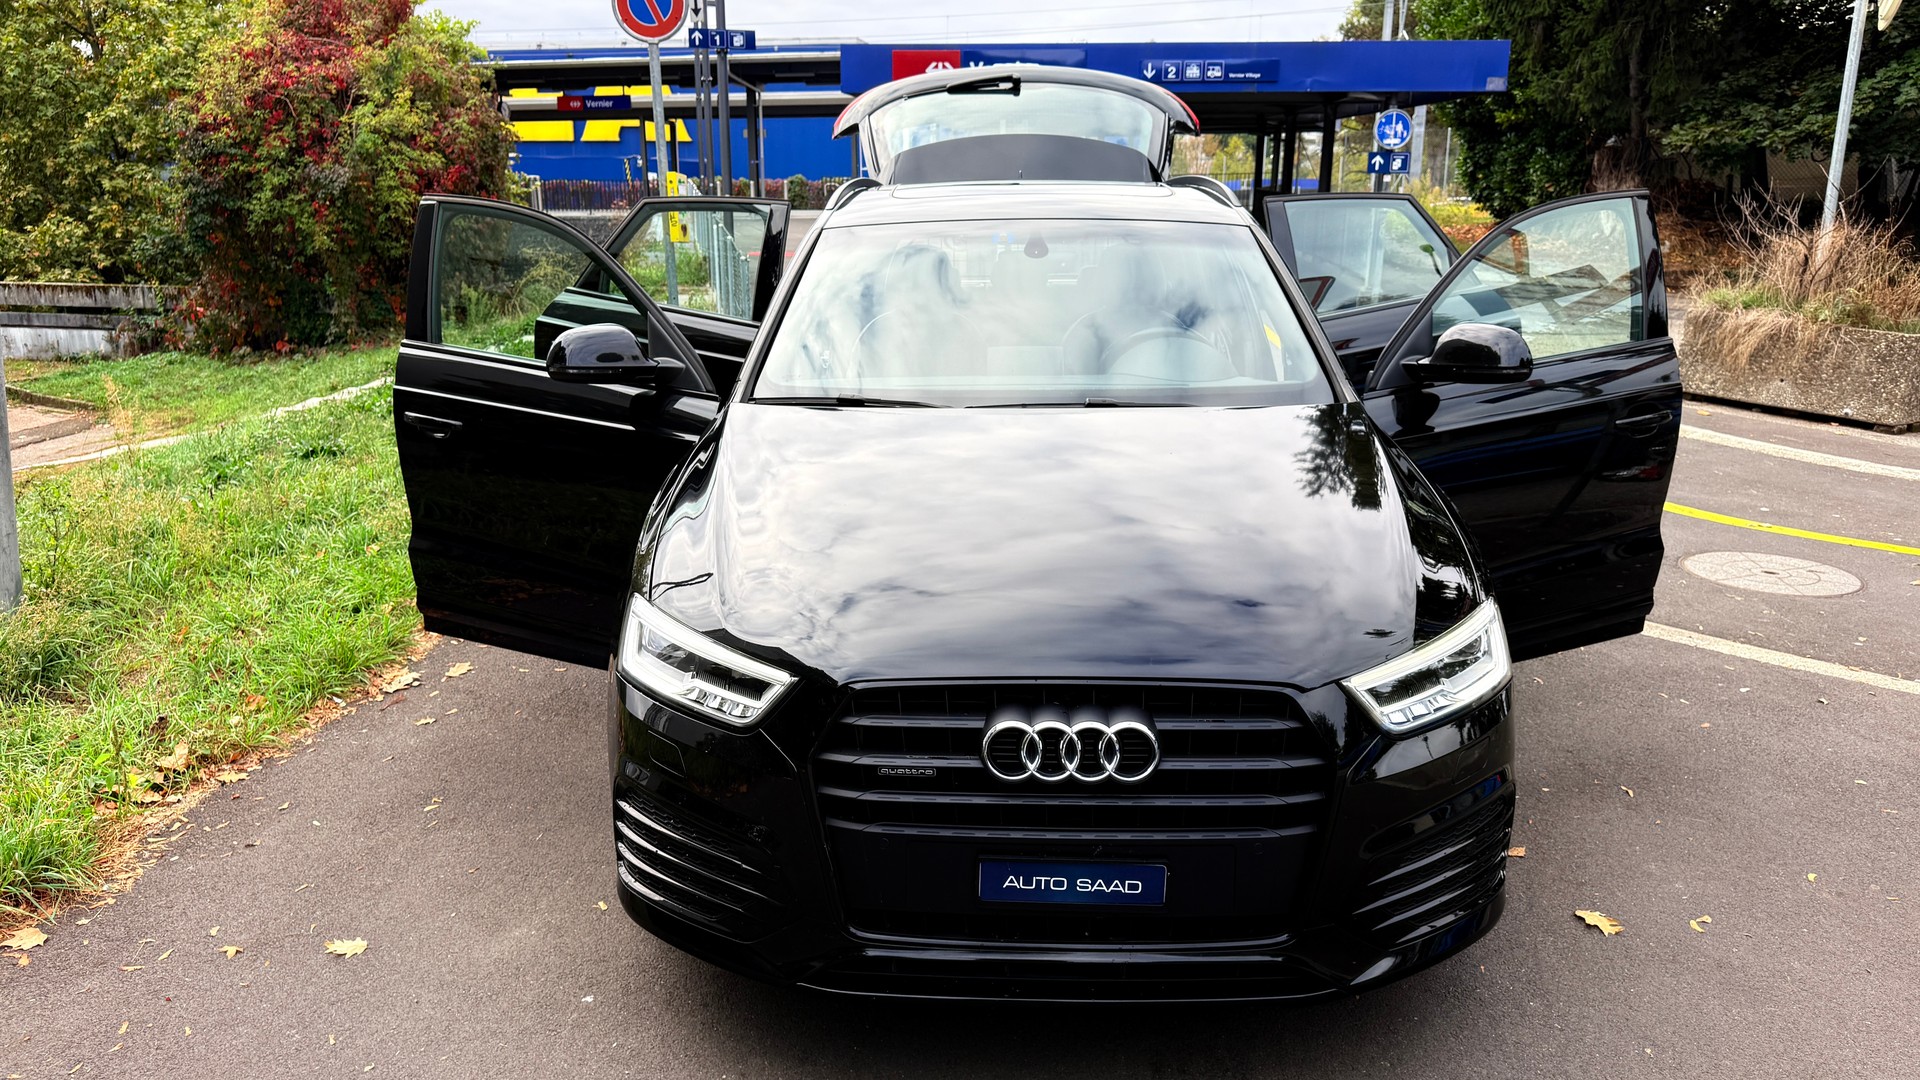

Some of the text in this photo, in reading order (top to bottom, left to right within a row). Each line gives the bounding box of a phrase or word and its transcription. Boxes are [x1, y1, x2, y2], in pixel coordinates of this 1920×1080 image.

[714, 34, 721, 46] 1
[1167, 66, 1176, 79] 2
[585, 99, 614, 108] Vernier
[1003, 875, 1142, 894] AUTO SAAD
